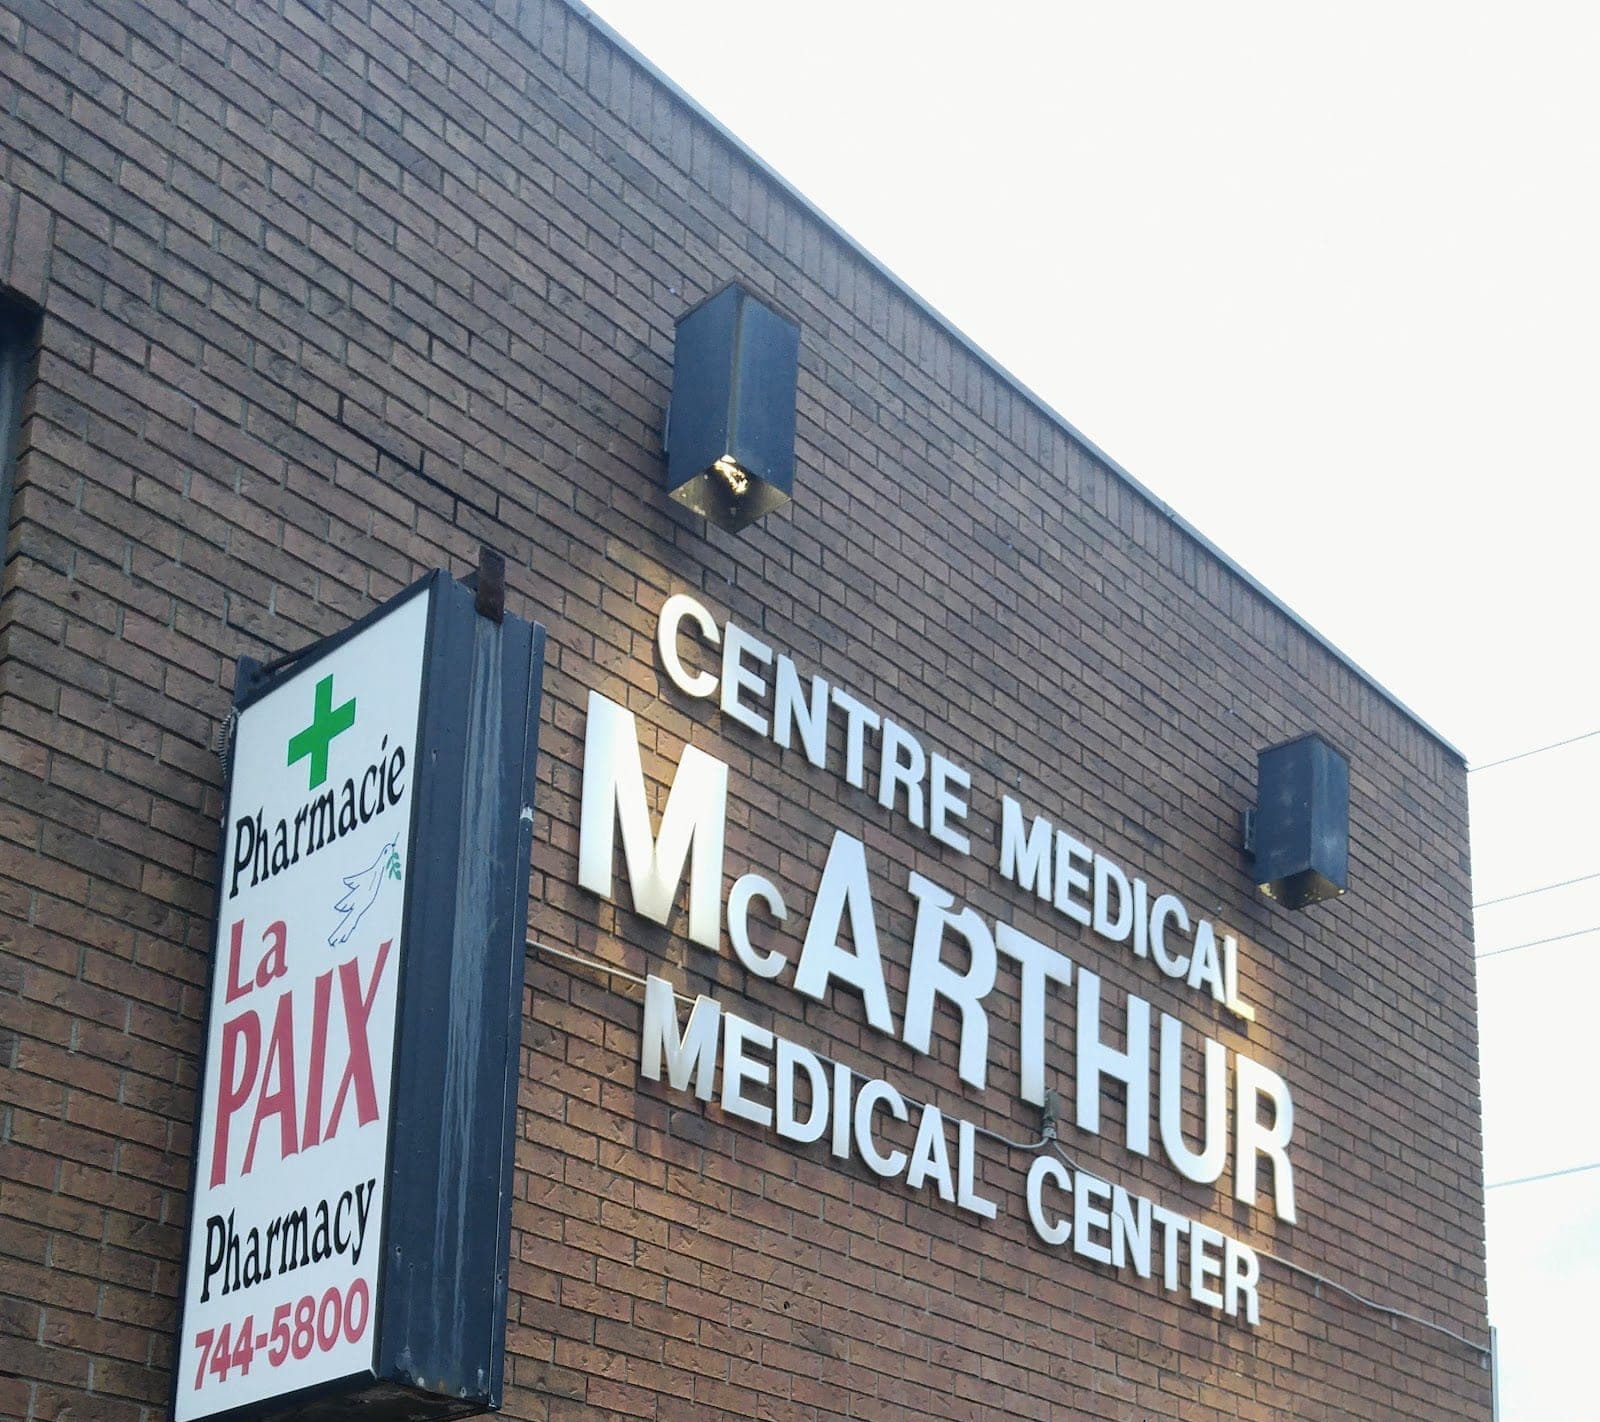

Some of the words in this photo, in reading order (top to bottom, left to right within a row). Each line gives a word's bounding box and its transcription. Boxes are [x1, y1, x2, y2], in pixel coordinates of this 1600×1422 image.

[229, 743, 406, 899] Pharmacie
[657, 593, 970, 856] CENTRE
[1000, 795, 1256, 1022] MEDICAL
[225, 919, 290, 1005] La
[209, 940, 394, 1190] PAIX
[641, 973, 997, 1220] MEDICAL
[1026, 1155, 1260, 1326] CENTER
[200, 1178, 376, 1304] Pharmacy
[194, 1277, 370, 1391] 744-5800
